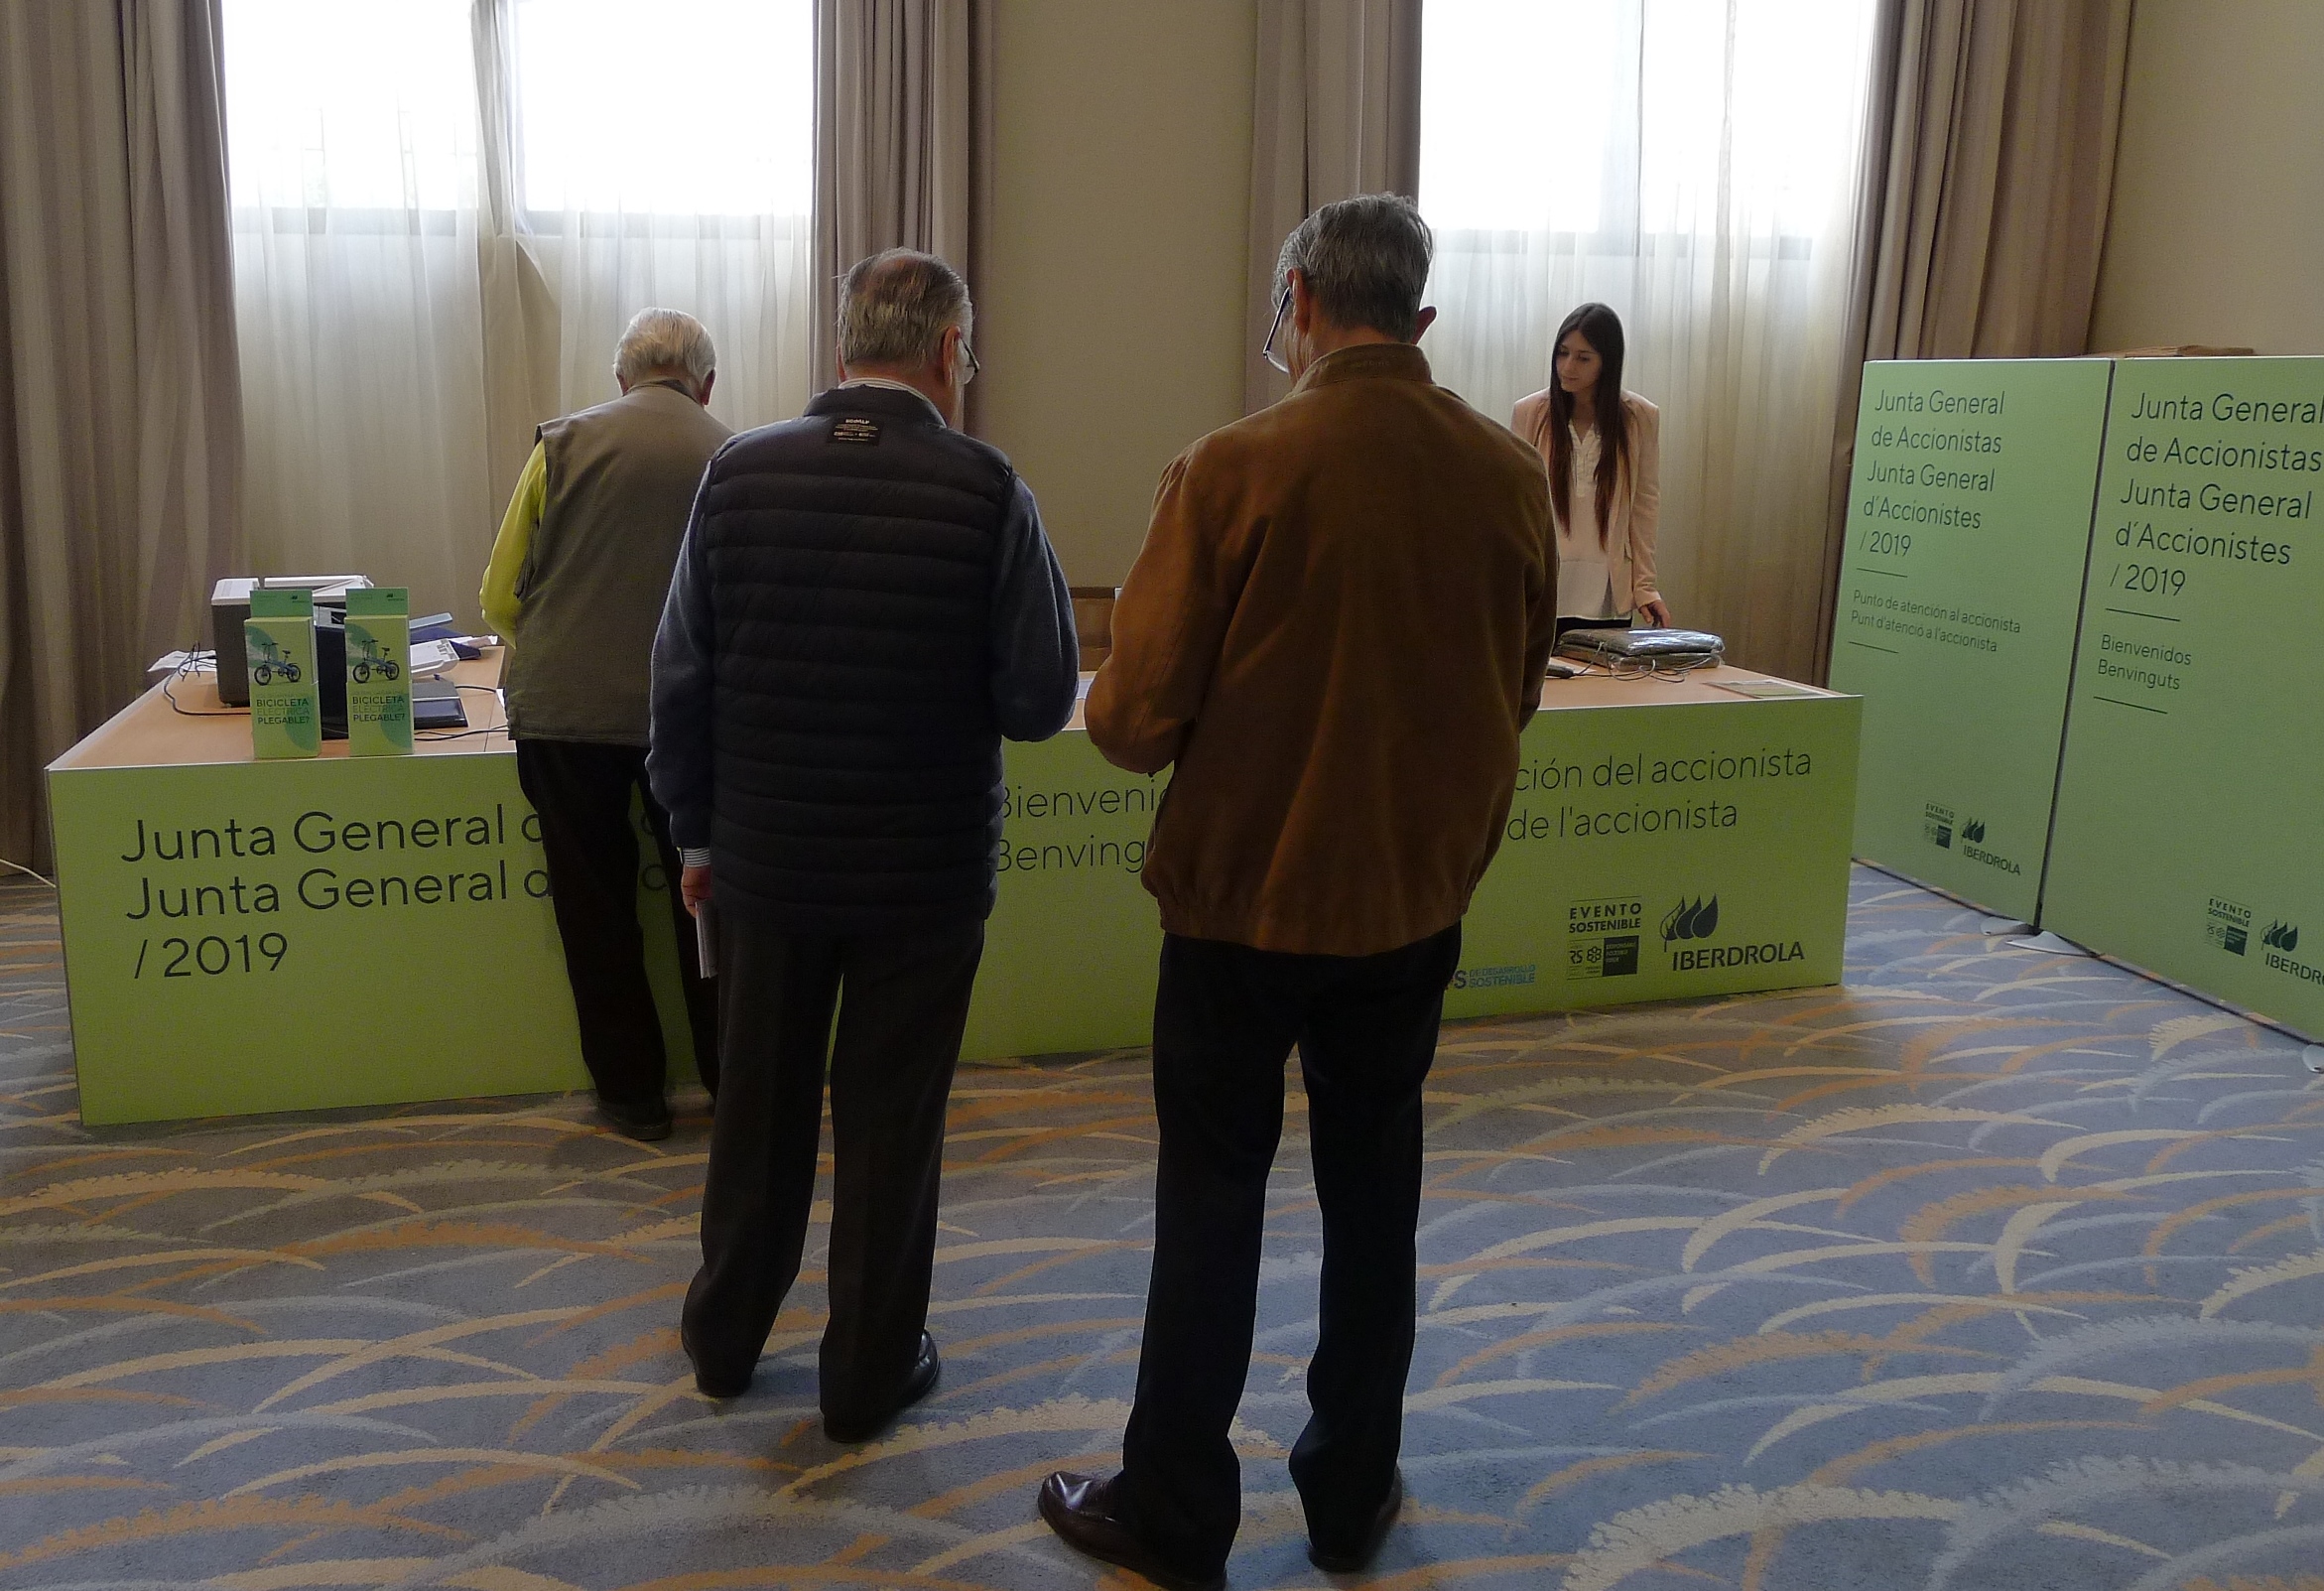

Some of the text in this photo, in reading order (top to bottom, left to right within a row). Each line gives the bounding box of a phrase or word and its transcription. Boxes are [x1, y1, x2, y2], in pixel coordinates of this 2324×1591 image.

[1874, 389, 2004, 415] Junta General
[2131, 392, 2324, 424] Junta General
[1872, 425, 2001, 454] de Accionistas
[2127, 436, 2322, 471] de Accionistas
[1868, 461, 1995, 492] Junta General
[2120, 478, 2312, 519] Junta General
[1851, 609, 1875, 626] Punt
[1926, 628, 1932, 639] a
[1854, 590, 1883, 607] Punto
[1885, 597, 1899, 610] de
[1949, 607, 1960, 621] al
[1962, 611, 2020, 633] accionista
[2101, 634, 2192, 666] Bienvenidos
[2098, 658, 2180, 690] Benvinguts
[256, 698, 310, 708] BICICLETA
[352, 695, 405, 705] BICICLETA
[257, 716, 311, 725] PLEGABLE?
[353, 713, 406, 723] PLEGABLE?
[1593, 753, 1642, 787] del
[1651, 747, 1811, 784] accionista
[120, 819, 276, 862] Junta
[293, 803, 504, 854] General
[1506, 800, 1738, 841] de l'accionista
[1964, 845, 2021, 876] IBERDROLA
[126, 876, 280, 920] Junta
[298, 860, 507, 910] General
[1569, 902, 1642, 920] EVENTO
[2209, 898, 2252, 919] EVENTO
[1569, 918, 1641, 933] SOSTENIBLE
[1672, 941, 1805, 972] IBERDROLA
[1469, 973, 1535, 989] SOSTENIBLE
